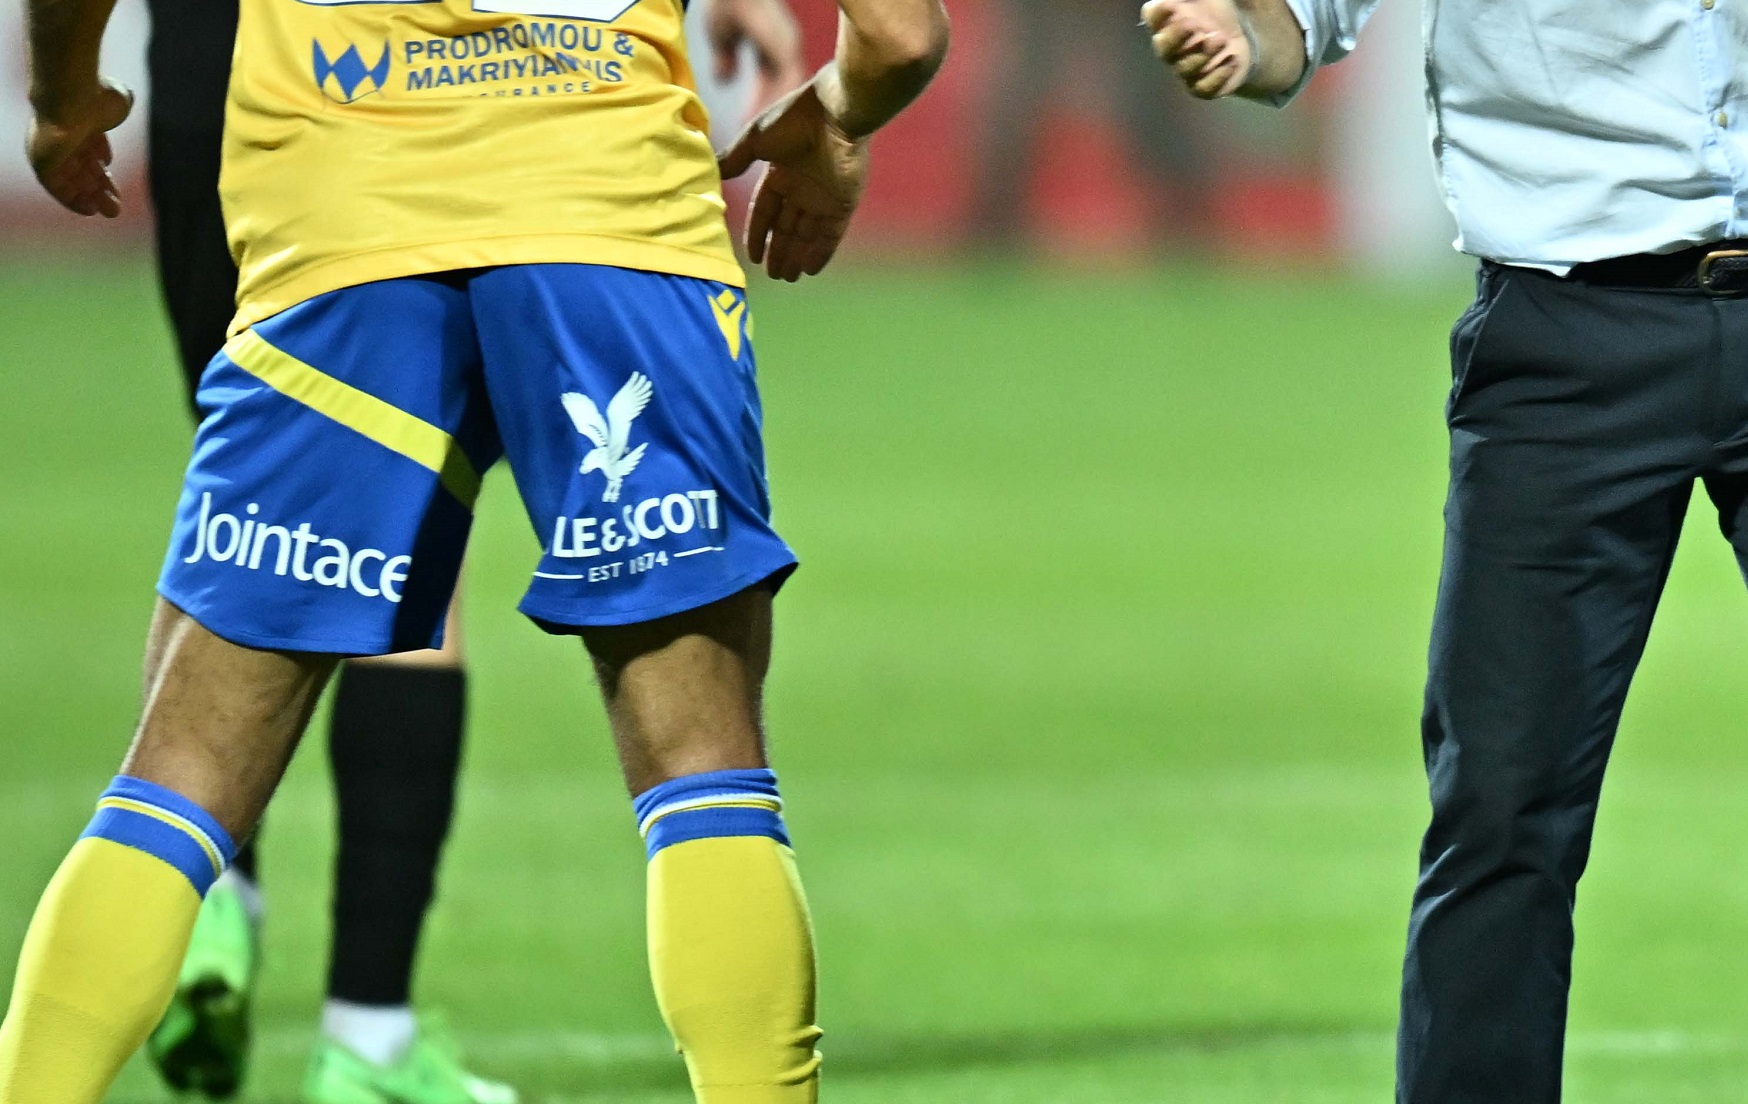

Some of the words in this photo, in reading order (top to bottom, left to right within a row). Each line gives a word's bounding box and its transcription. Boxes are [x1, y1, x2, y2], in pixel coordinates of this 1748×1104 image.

[404, 22, 602, 65] PRODROMOU
[613, 31, 634, 58] &
[406, 51, 623, 92] MAKRIYIANIS
[184, 491, 413, 603] Jointace
[601, 517, 626, 552] &
[588, 562, 624, 583] EST
